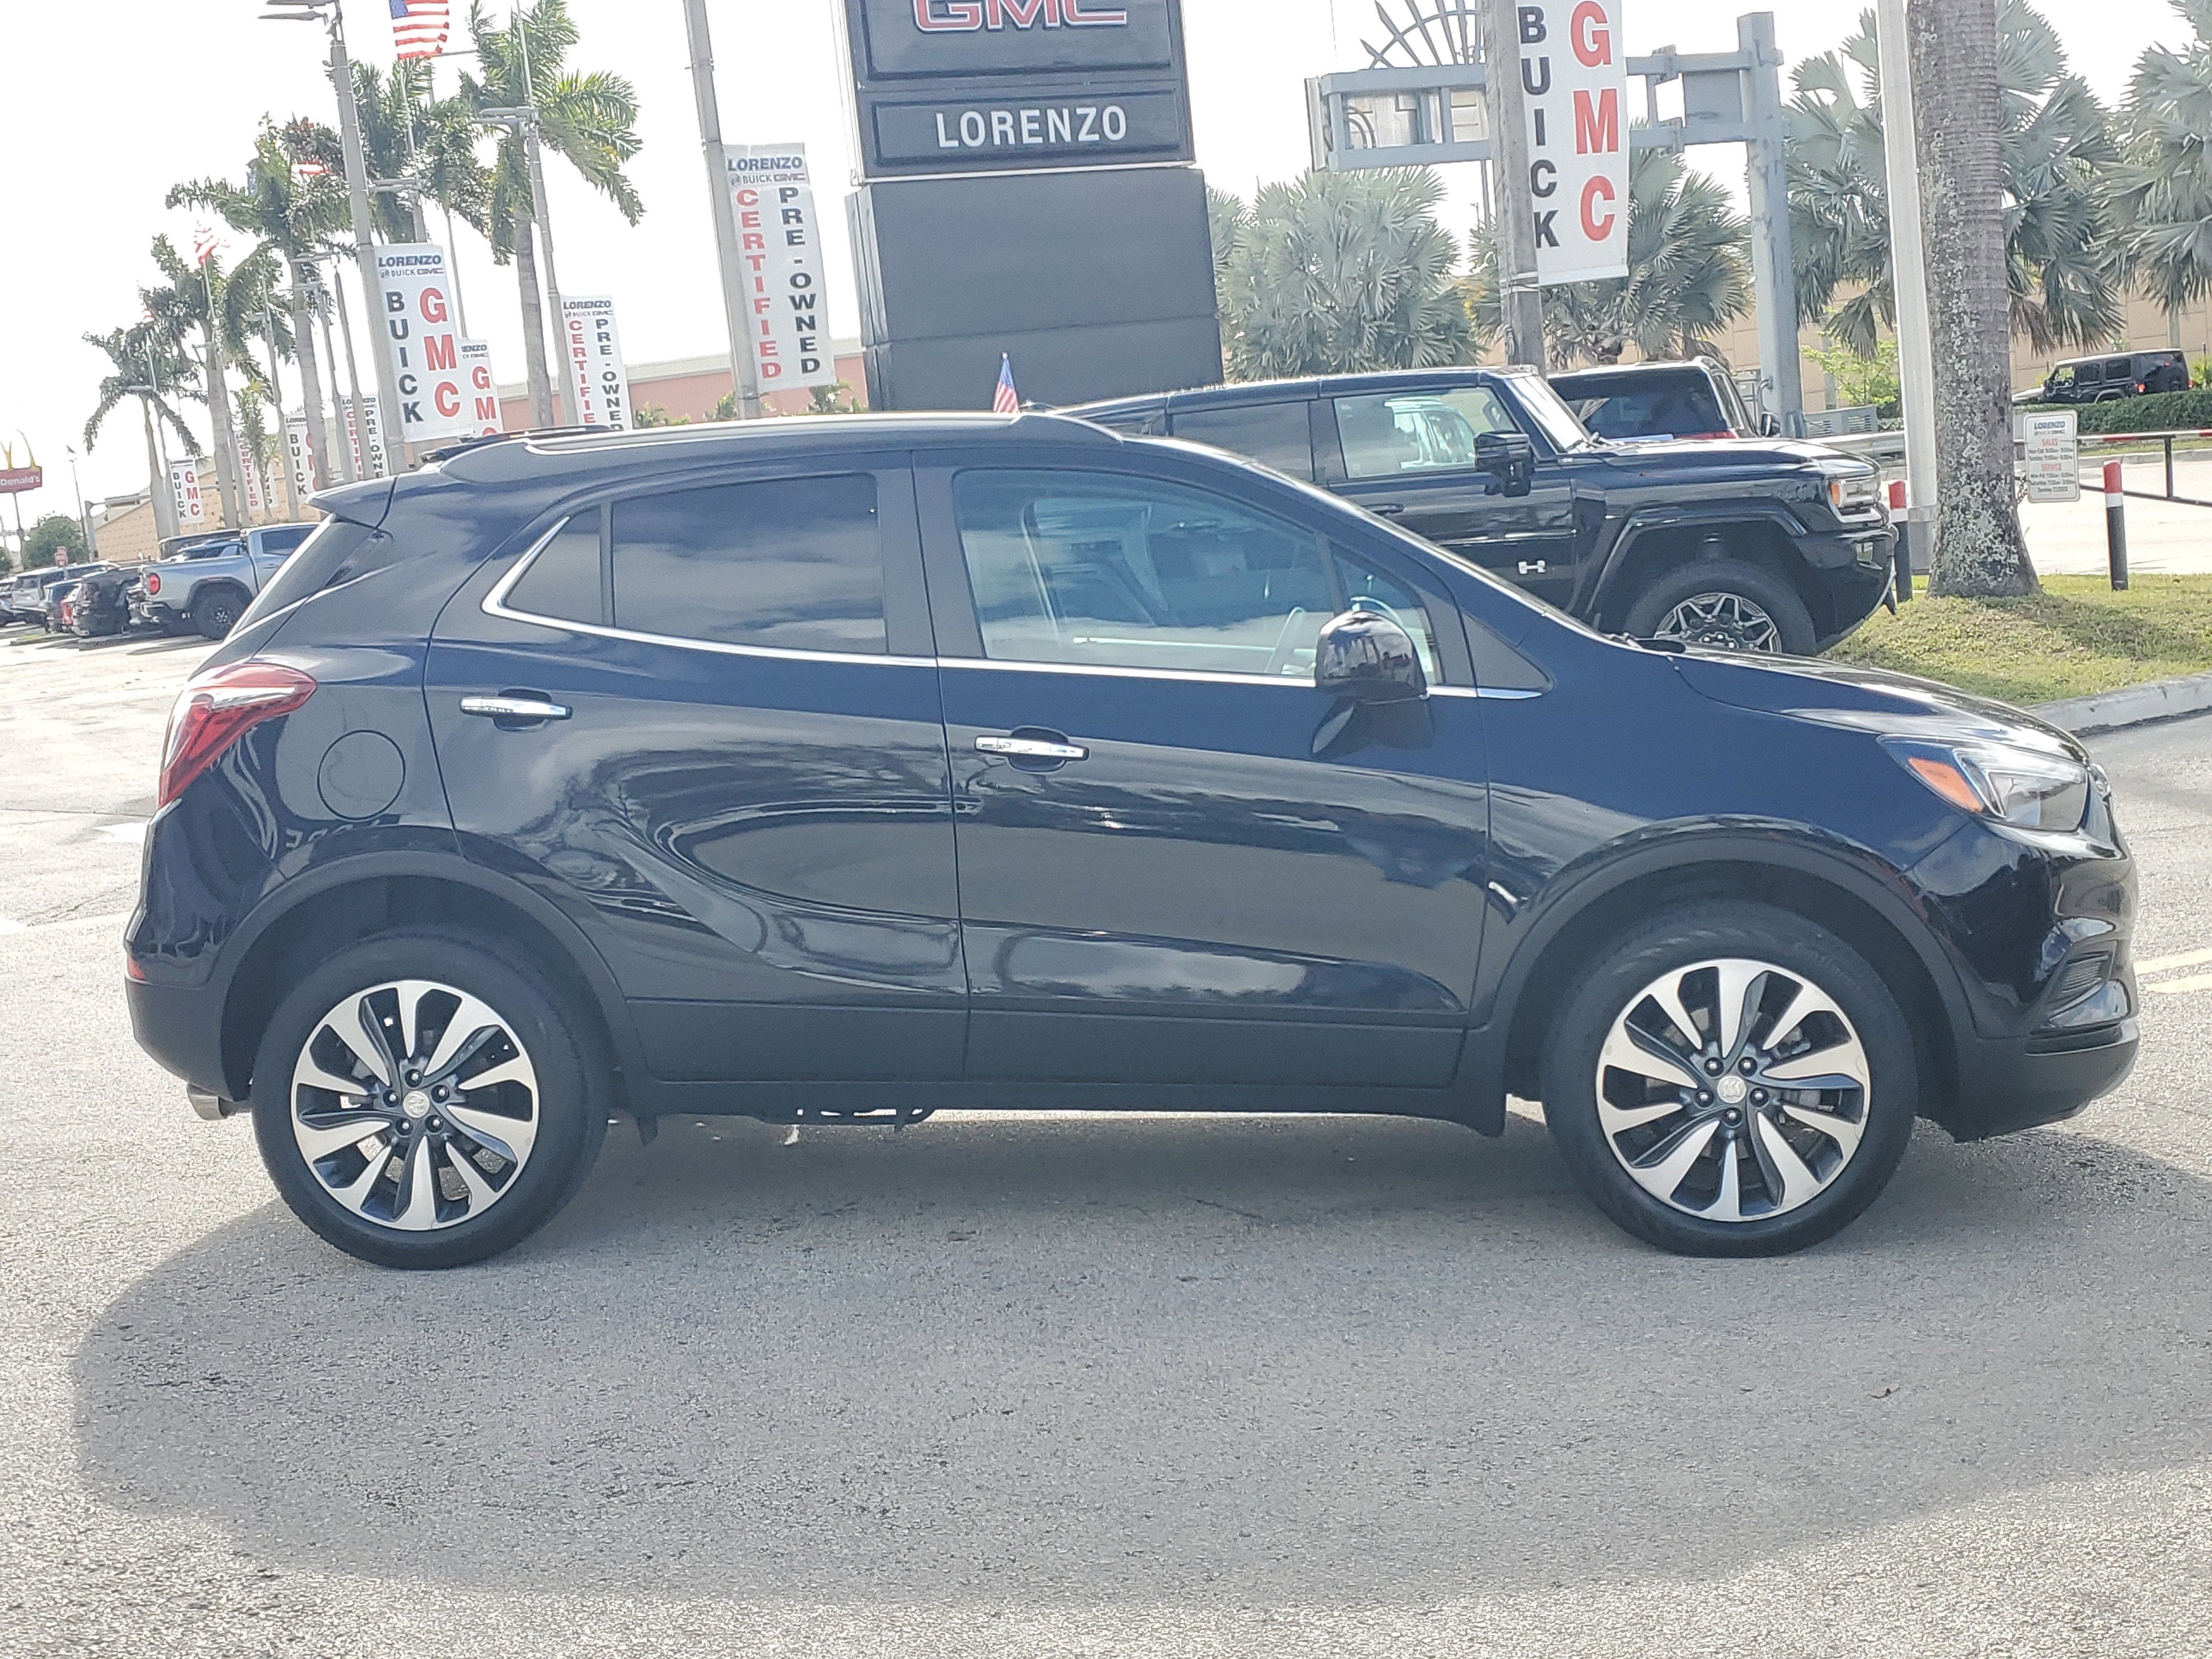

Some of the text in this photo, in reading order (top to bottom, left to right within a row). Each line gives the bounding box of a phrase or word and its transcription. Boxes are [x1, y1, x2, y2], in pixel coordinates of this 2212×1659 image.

[913, 0, 1127, 31] GMC
[936, 106, 1126, 147] LORENZO
[1517, 5, 1560, 249] BUICK
[1571, 1, 1619, 241] GMC
[728, 156, 803, 171] LORENZO
[743, 173, 805, 184] BUICK GMC
[378, 255, 442, 267] LORENZO
[737, 189, 782, 379] CERTIFIED
[563, 301, 611, 309] LORENZO
[386, 291, 424, 423] BUICK
[420, 287, 460, 417] GMC
[569, 320, 596, 424] CERTIFIE
[365, 410, 383, 478] PRE-OWNE
[2034, 421, 2065, 430] LORENZO
[290, 434, 307, 495] BUICK
[173, 472, 187, 518] BUICK
[185, 471, 200, 516] GMC
